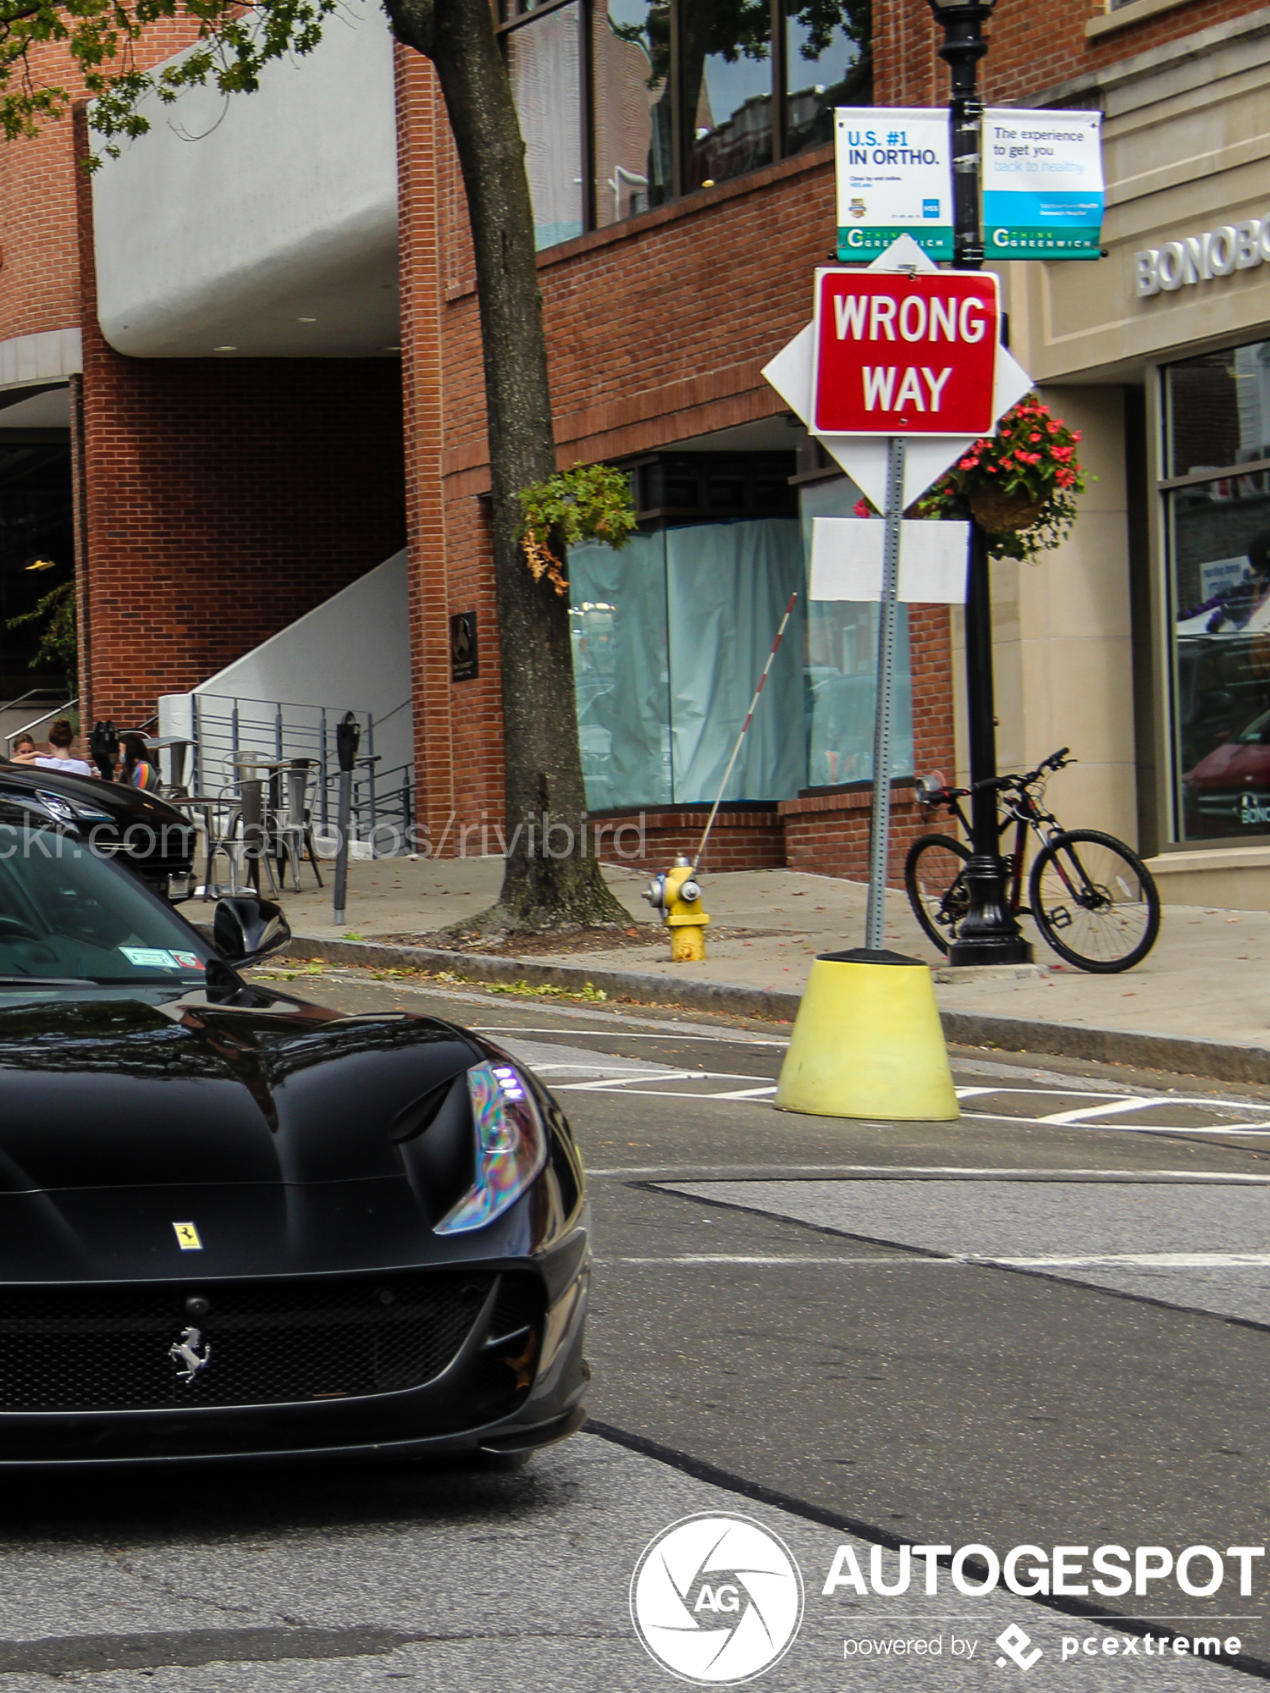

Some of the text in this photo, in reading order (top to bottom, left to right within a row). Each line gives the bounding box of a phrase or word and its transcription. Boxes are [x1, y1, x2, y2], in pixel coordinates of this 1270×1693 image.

[848, 131, 908, 146] U.S. #1
[994, 127, 1084, 142] The experience
[849, 149, 939, 165] IN ORTHO.
[994, 144, 1054, 158] to get you
[994, 161, 1085, 174] back to healthy
[1010, 240, 1091, 248] GREENWICH
[833, 295, 986, 344] WRONG
[862, 366, 953, 412] WAY
